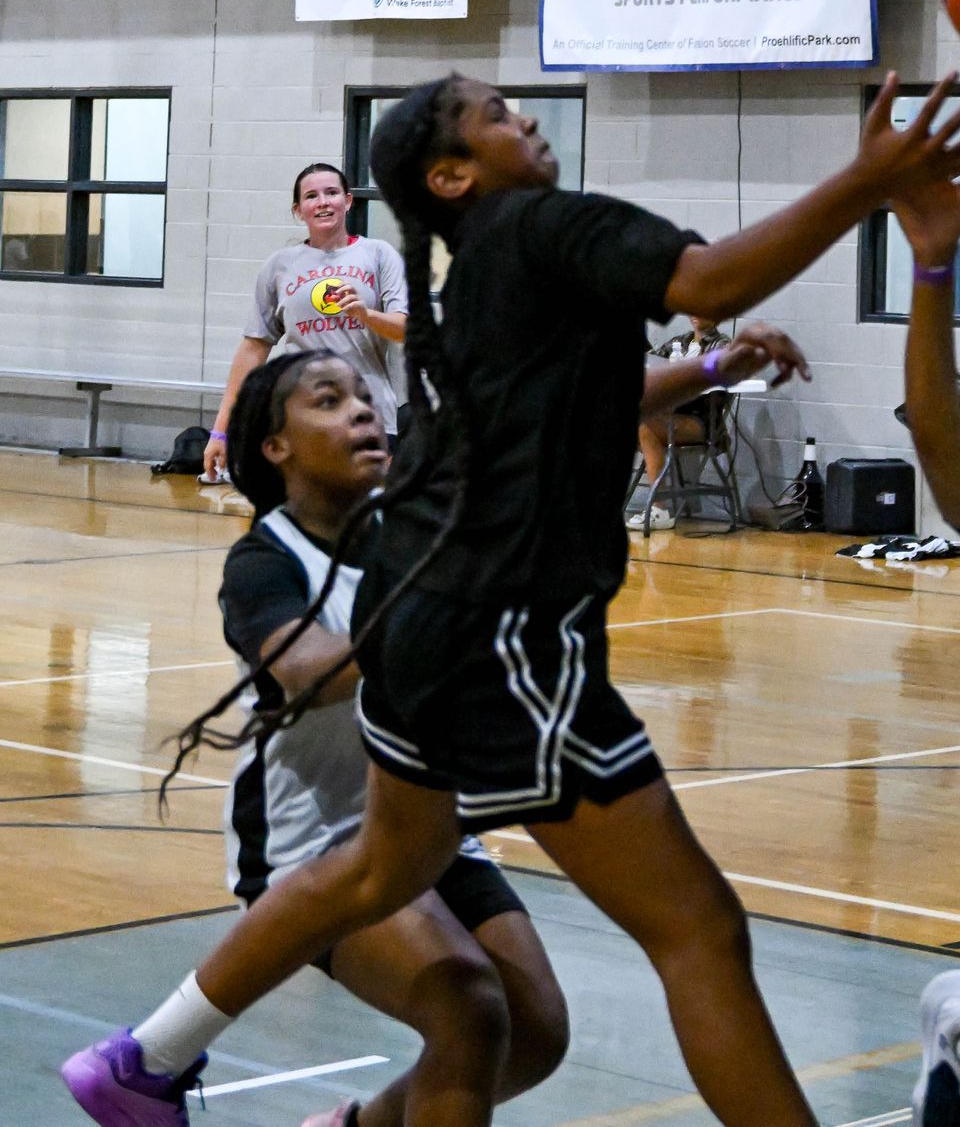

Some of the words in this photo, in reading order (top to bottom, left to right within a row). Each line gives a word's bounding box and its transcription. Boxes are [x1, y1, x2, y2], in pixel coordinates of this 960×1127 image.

[411, 0, 432, 7] Forest
[553, 39, 565, 49] An
[568, 39, 604, 50] Official
[607, 39, 644, 52] Training
[646, 39, 675, 50] Center
[717, 36, 751, 48] Soccer
[761, 34, 861, 47] ProehlificPark.com
[286, 265, 375, 296] CAROLINA
